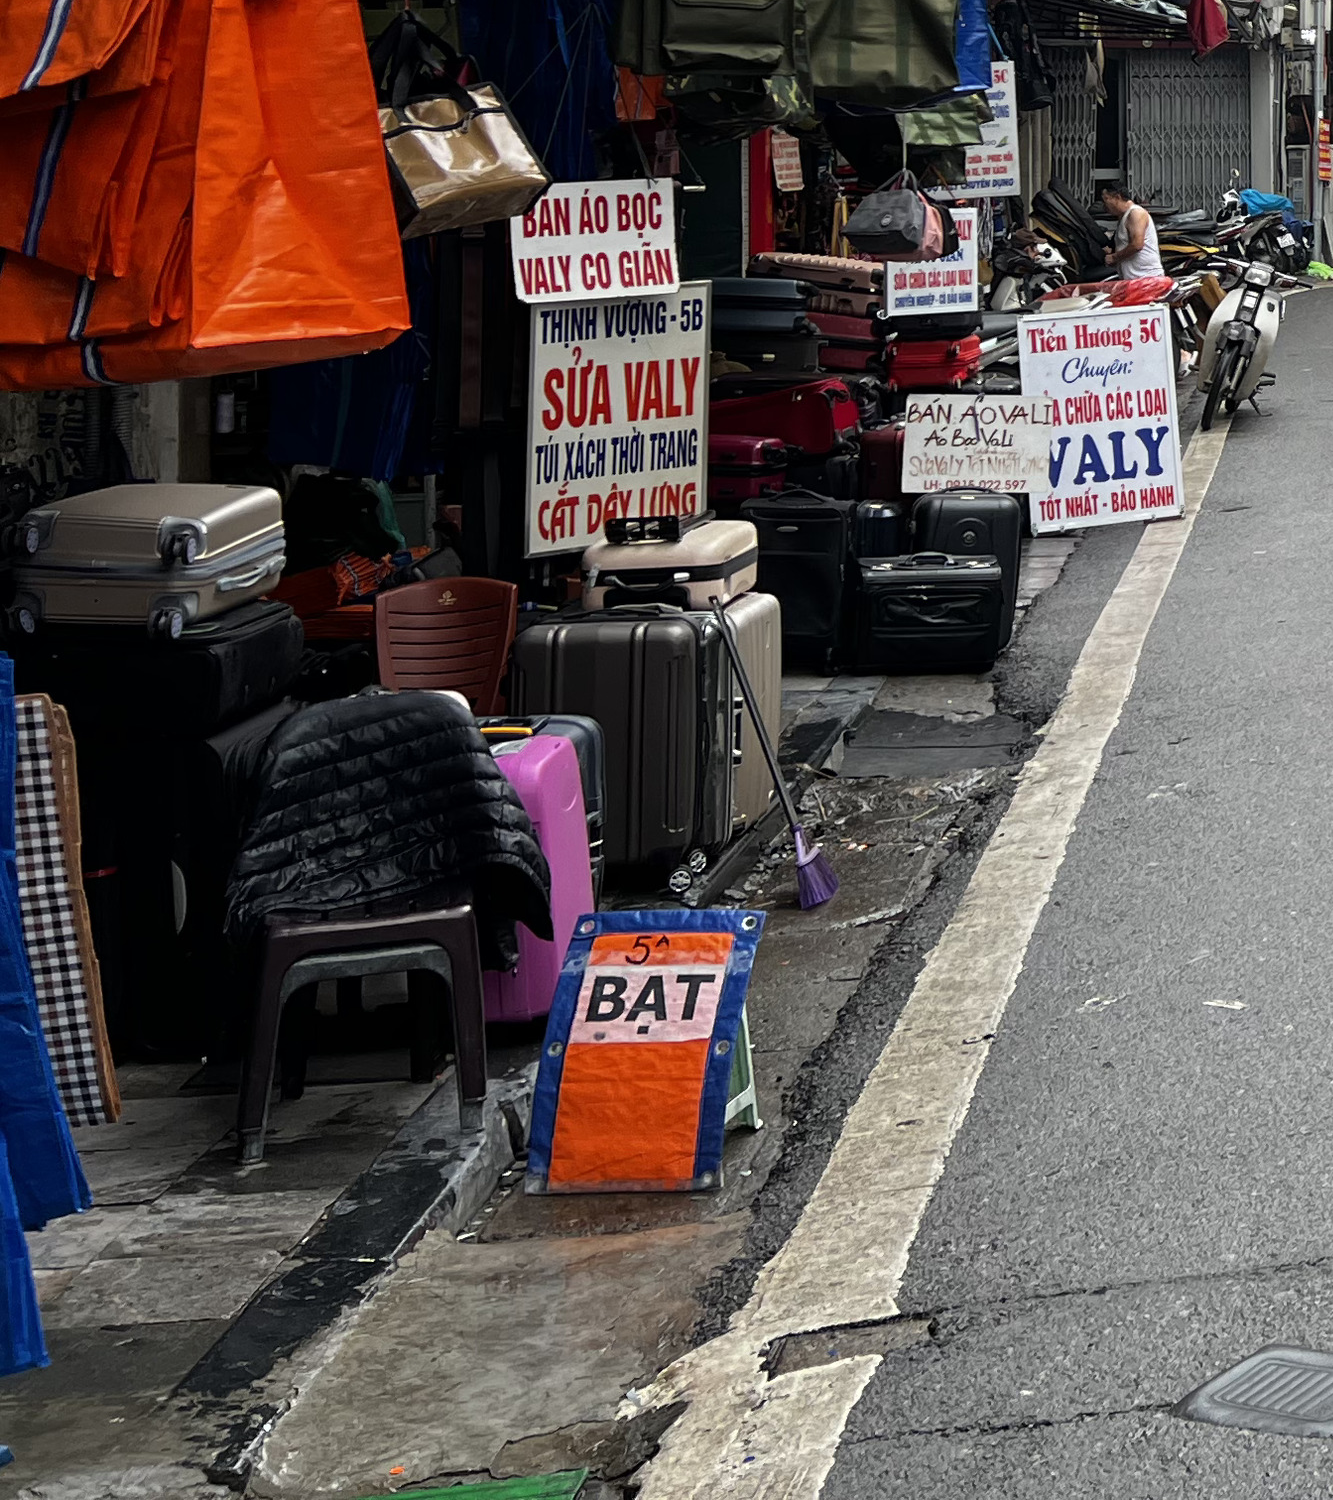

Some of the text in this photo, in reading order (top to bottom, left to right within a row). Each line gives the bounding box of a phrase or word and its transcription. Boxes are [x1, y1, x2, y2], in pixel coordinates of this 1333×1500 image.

[994, 69, 1008, 84] 5C
[523, 188, 662, 238] BÁN ÁO BỌC
[519, 242, 675, 295] VALY CO GIÃN
[540, 299, 703, 348] THỊNH VƯỢNG 5B
[1027, 318, 1161, 354] Tiến Hương 5C
[541, 346, 700, 431] SỬA VALY
[1062, 357, 1133, 387] Chuyên:
[907, 398, 952, 424] BÁN
[1065, 390, 1103, 425] CHỮA
[1106, 386, 1133, 421] CÁC
[1138, 388, 1167, 422] LOẠI
[535, 427, 698, 485] TÚI XÁCH THỜI TRANG
[924, 426, 948, 447] Áo
[1049, 426, 1169, 488] VALY
[924, 480, 941, 490] LH:
[1039, 483, 1174, 521] TỐT NHẤT BẢO HÀNH
[538, 481, 580, 543] CẮT
[626, 935, 669, 964] 5A
[585, 975, 716, 1034] BẠT
